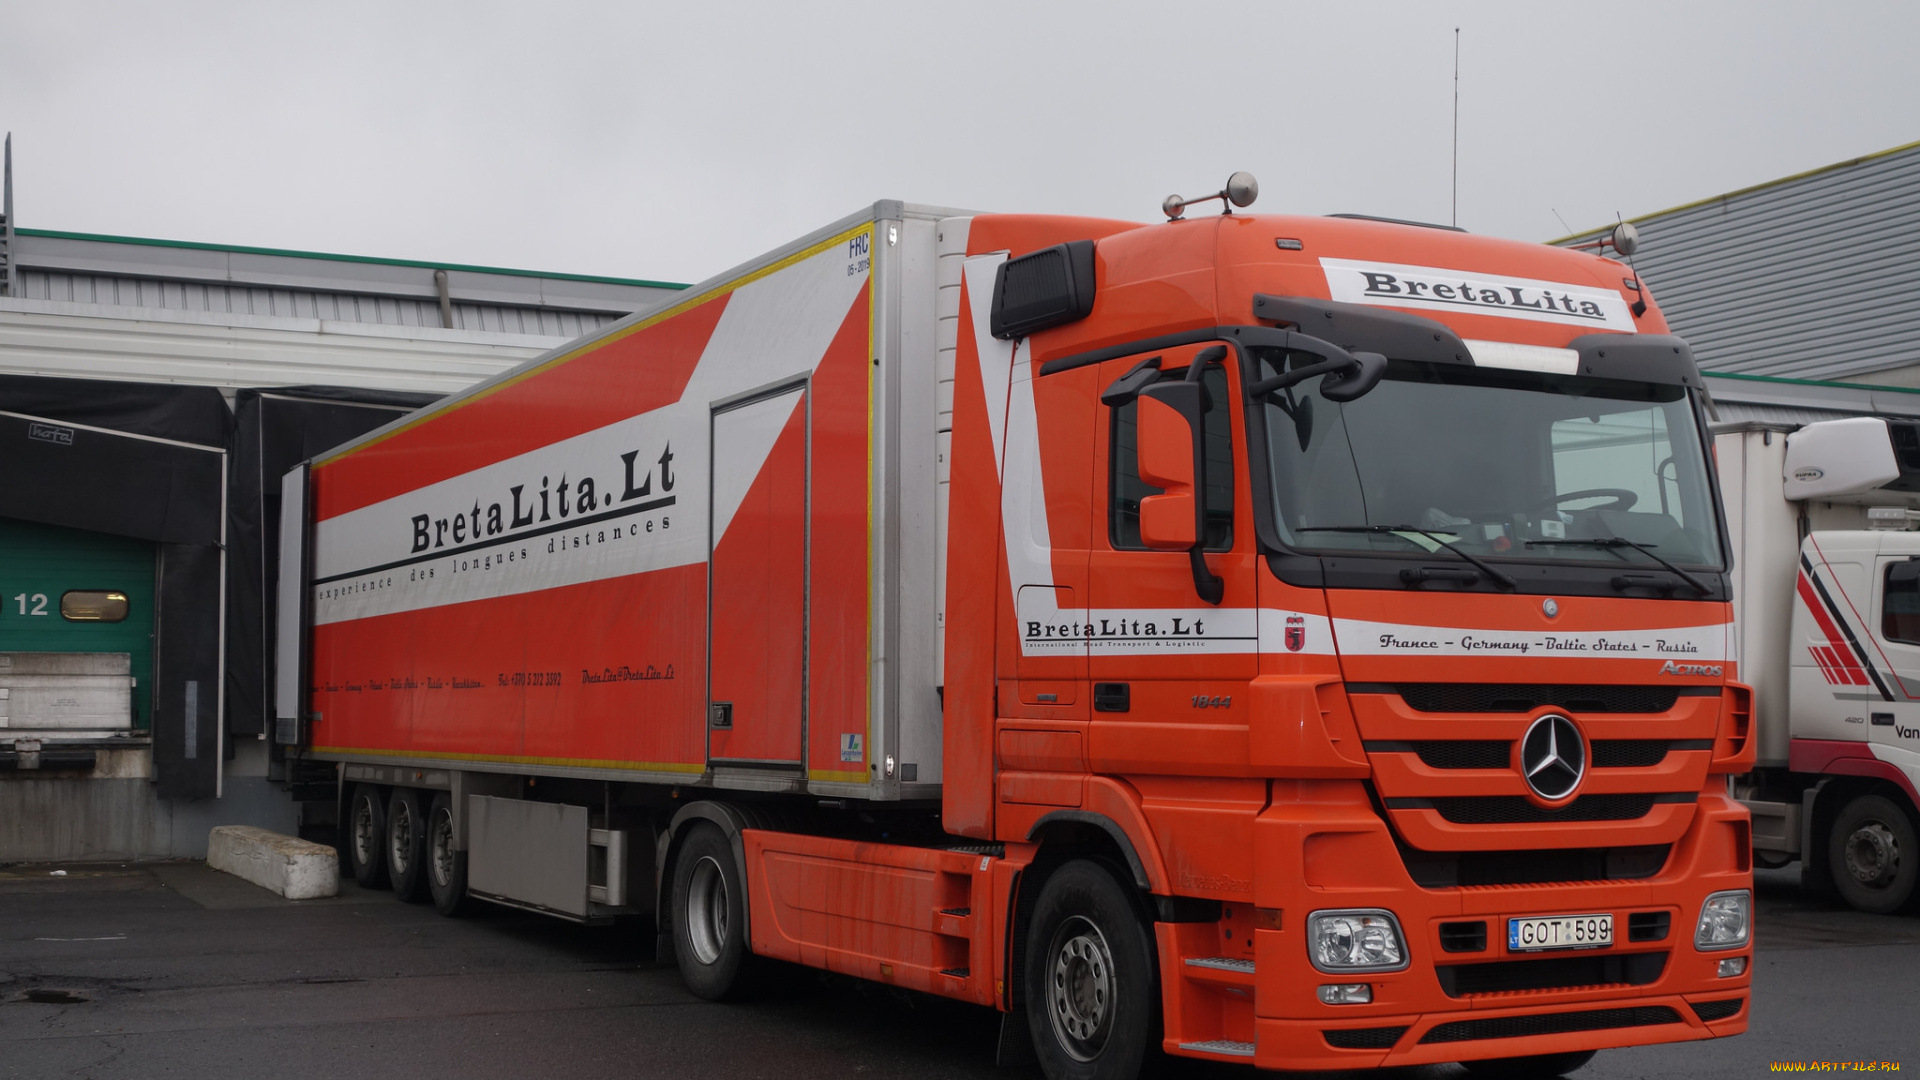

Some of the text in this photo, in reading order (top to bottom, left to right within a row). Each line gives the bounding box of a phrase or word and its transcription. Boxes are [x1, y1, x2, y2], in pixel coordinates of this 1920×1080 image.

[849, 233, 869, 259] FRC
[1359, 271, 1604, 317] BretaLita
[411, 438, 675, 555] BretaLita.Lt
[319, 515, 671, 600] experience des longues distances
[14, 593, 48, 615] 12
[1026, 618, 1205, 638] BretaLita.Lt
[1379, 634, 1699, 653] France Germany Baltic States Russia
[1191, 695, 1232, 709] 1844
[1510, 936, 1519, 944] LT
[1522, 919, 1608, 944] GOT 599
